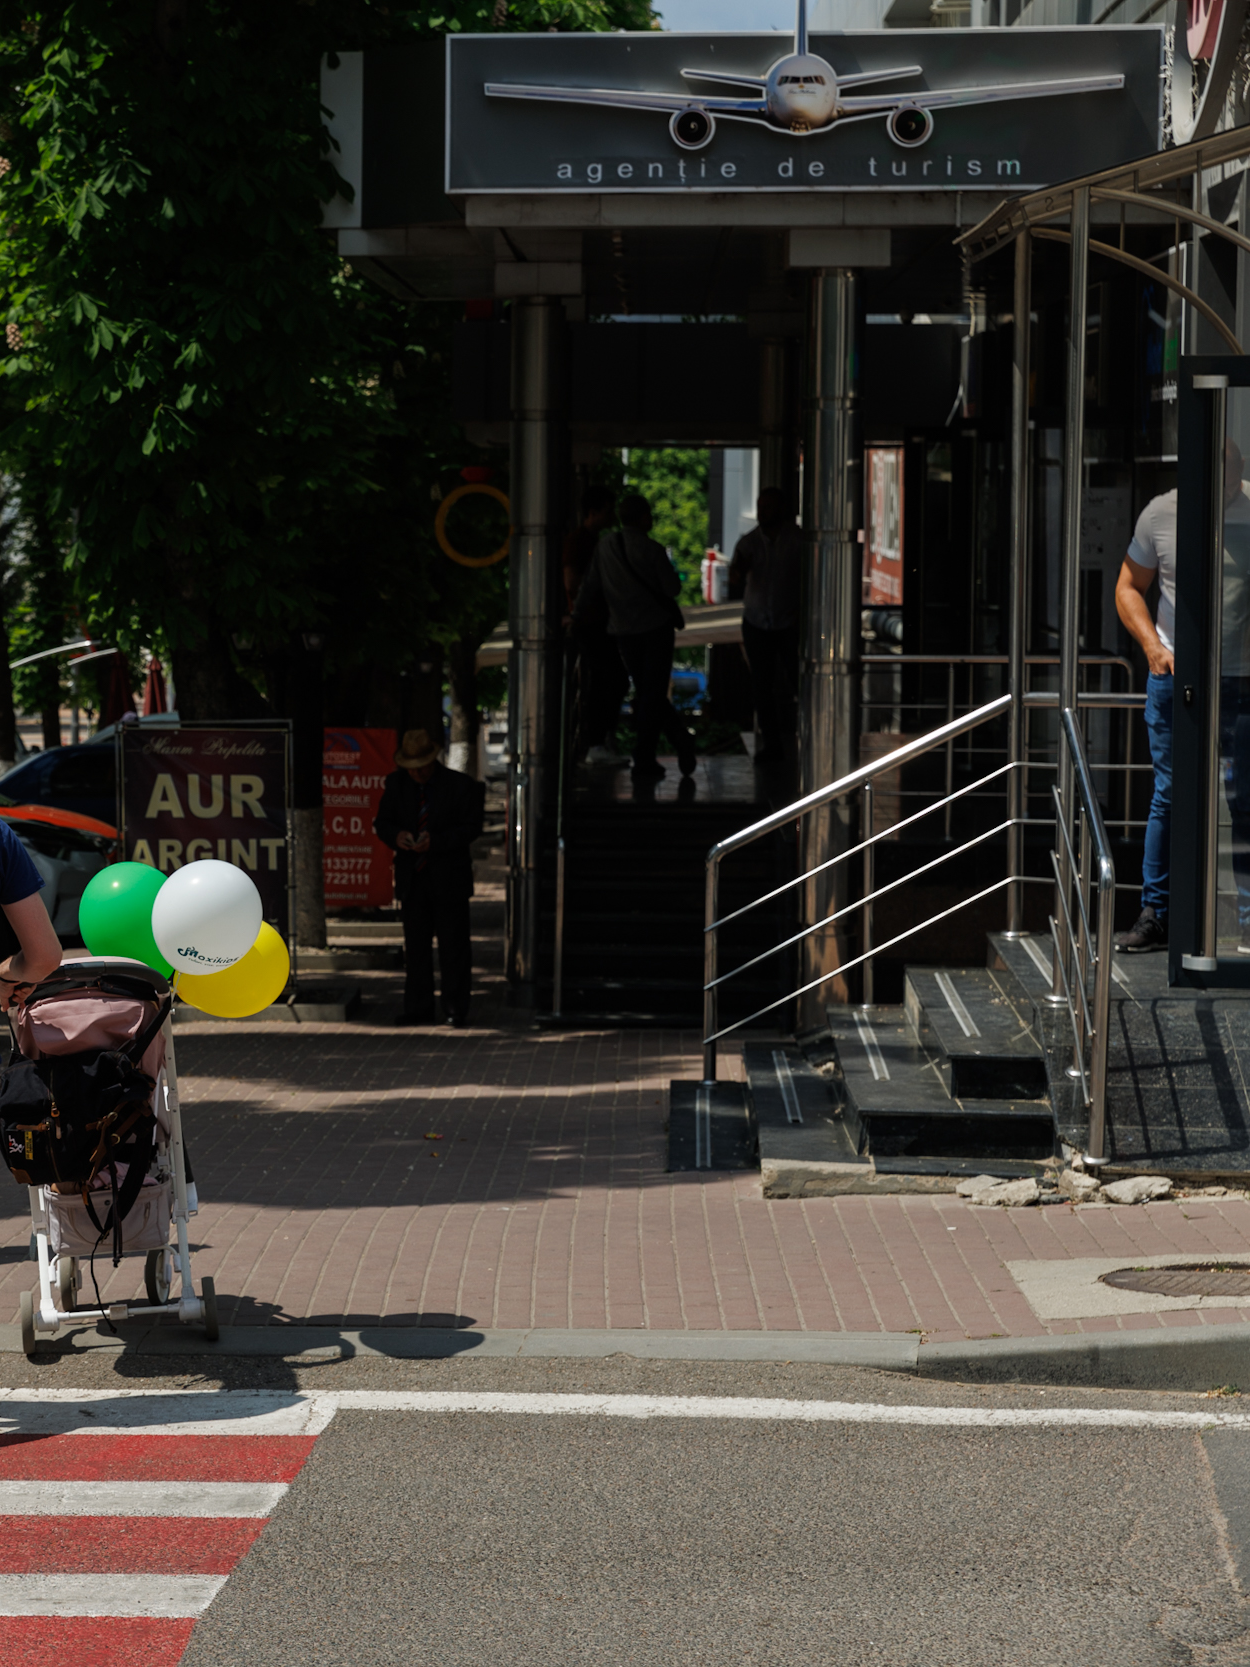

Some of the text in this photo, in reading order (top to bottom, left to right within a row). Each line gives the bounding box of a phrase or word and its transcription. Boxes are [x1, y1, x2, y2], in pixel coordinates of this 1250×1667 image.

[556, 155, 1021, 184] agenție de turism
[145, 773, 267, 819] AUR
[322, 774, 350, 789] ALA
[131, 838, 285, 871] ARGINT
[322, 857, 372, 871] 133777
